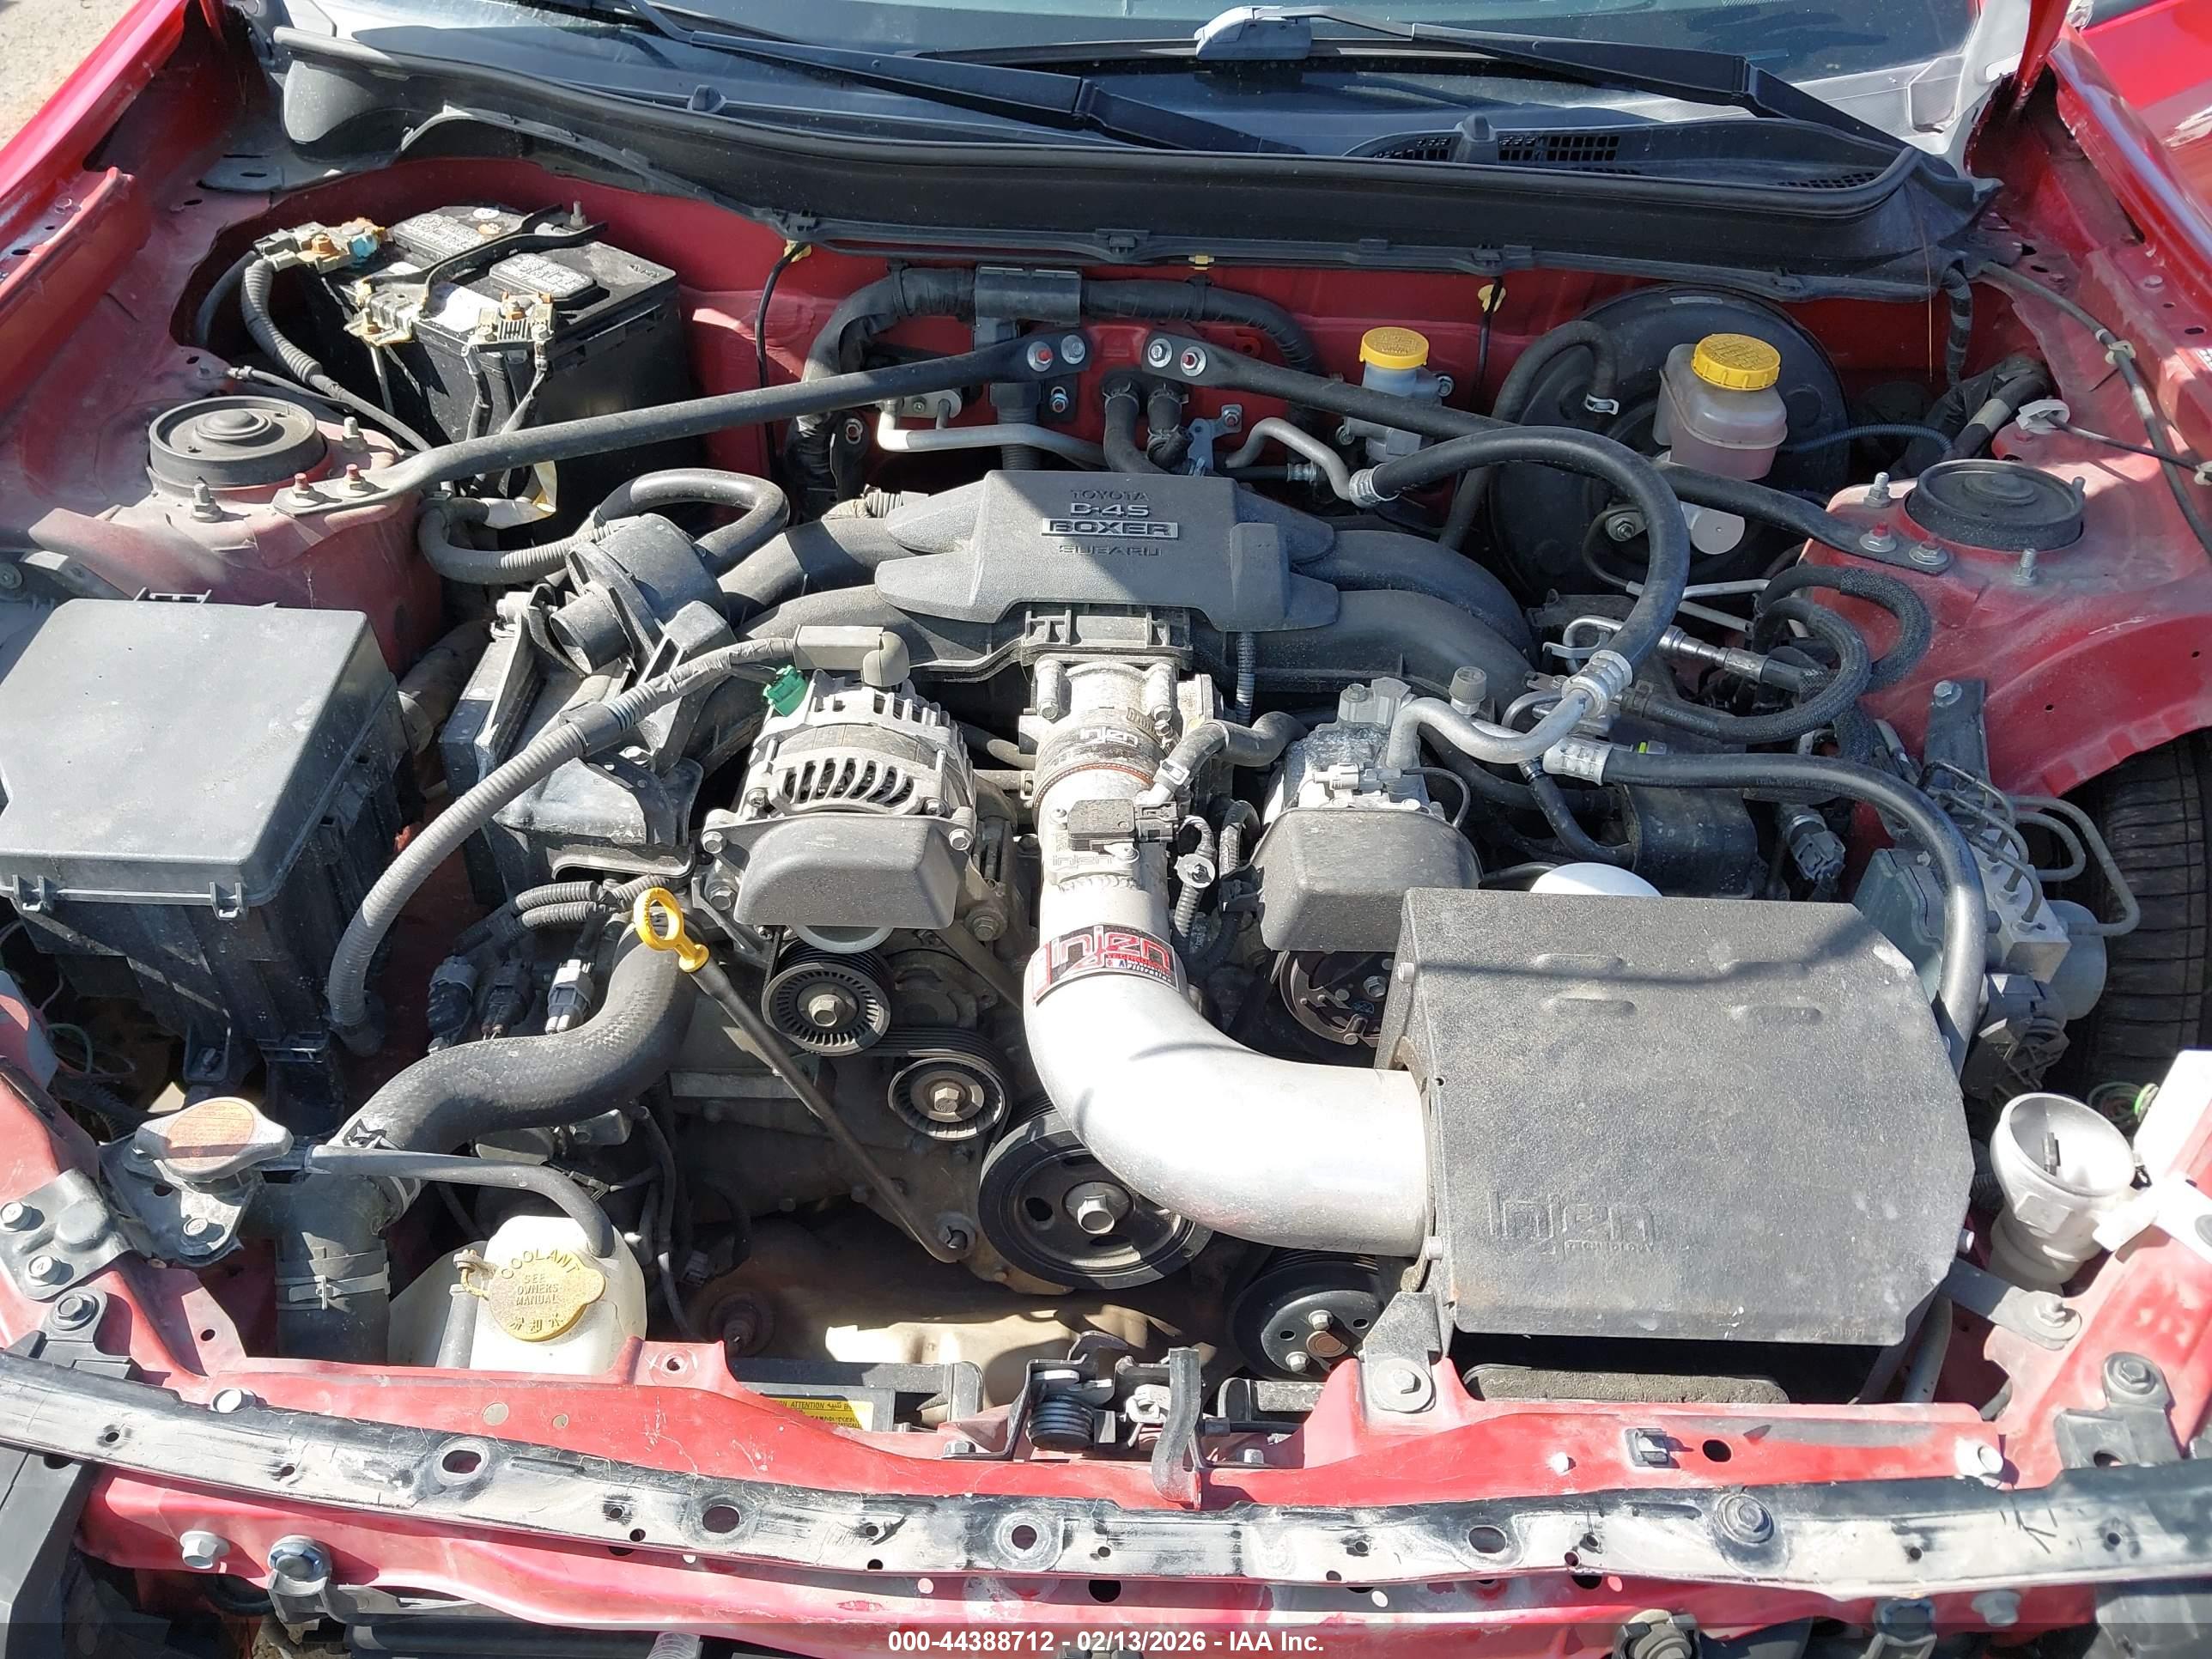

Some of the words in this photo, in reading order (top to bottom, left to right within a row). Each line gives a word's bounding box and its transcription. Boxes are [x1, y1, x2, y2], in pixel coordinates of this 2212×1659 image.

[1071, 489, 1150, 501] TOYOTA
[1071, 502, 1150, 517] D-4S
[1048, 519, 1174, 538] BOXER
[1059, 544, 1163, 556] SUBARU
[501, 1248, 580, 1279] COOLANT
[524, 1273, 547, 1284] SEE
[516, 1283, 559, 1296] OWNERS
[515, 1293, 558, 1306] MANUAL
[790, 1401, 824, 1409] ATTENTION
